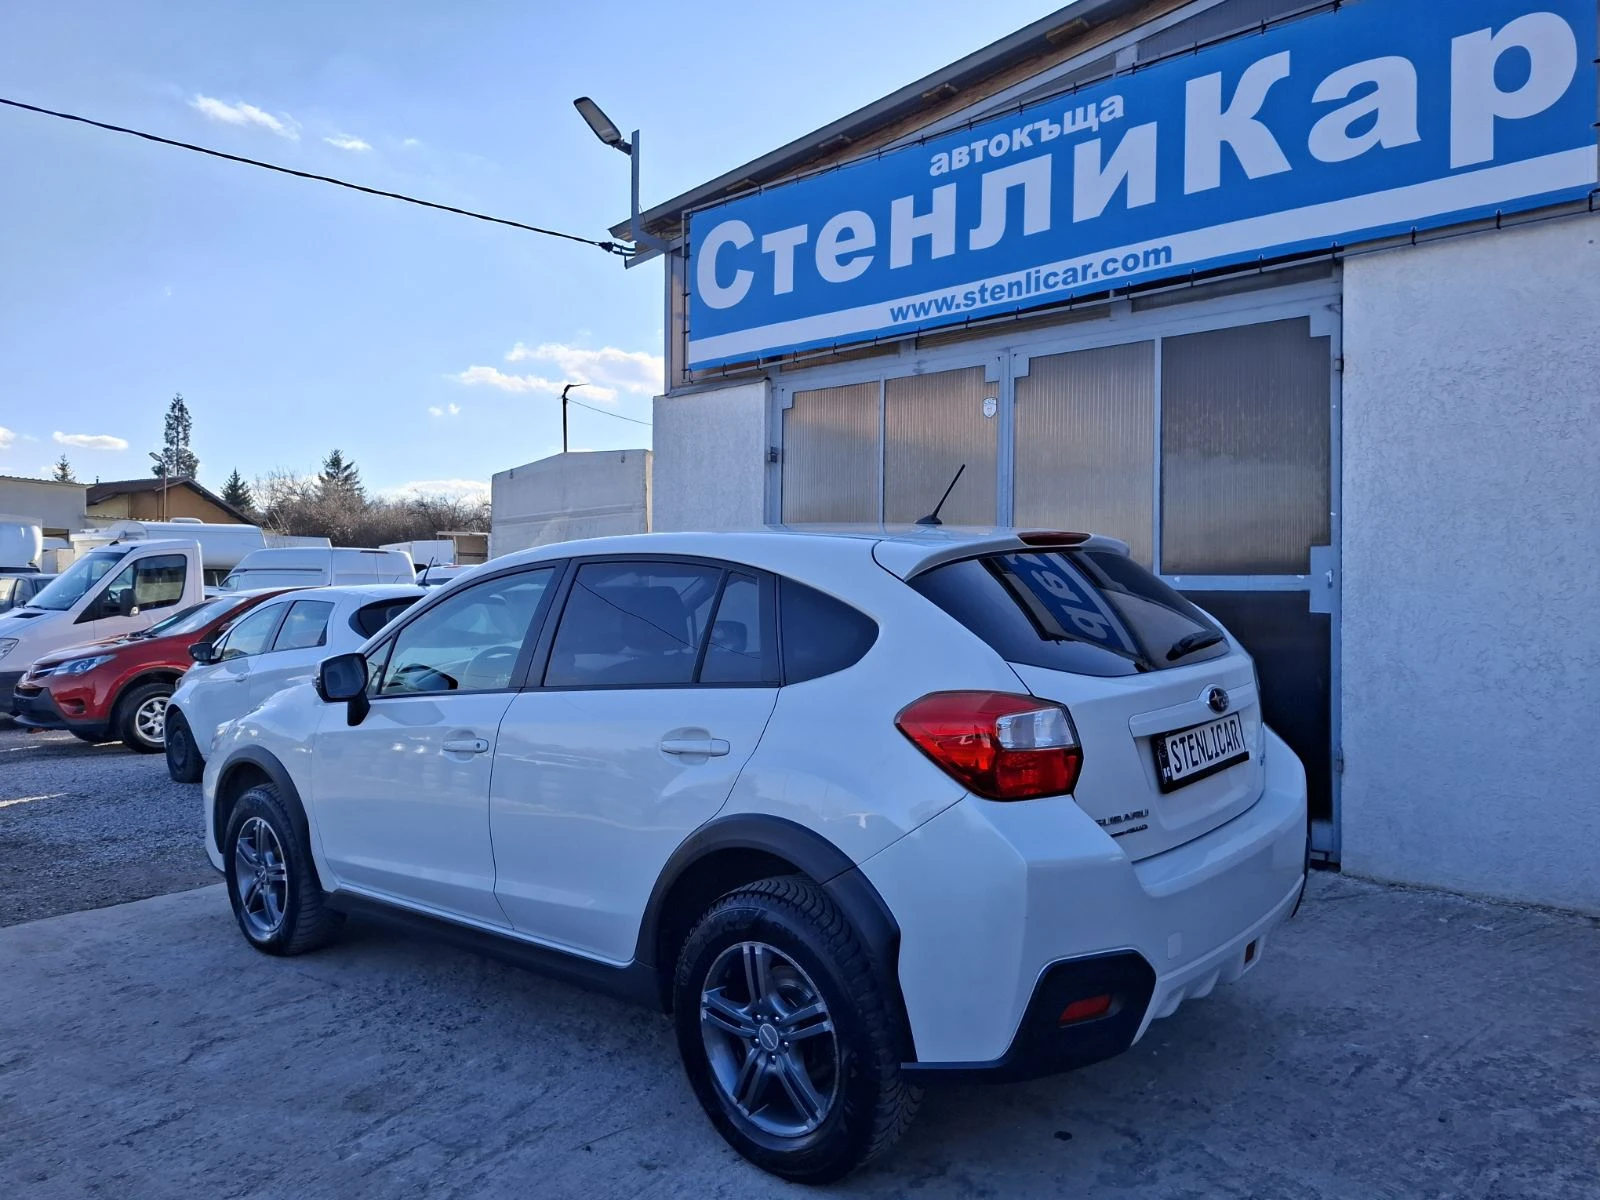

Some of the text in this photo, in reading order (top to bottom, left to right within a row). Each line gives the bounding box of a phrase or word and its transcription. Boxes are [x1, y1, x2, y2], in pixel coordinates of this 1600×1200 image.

[929, 95, 1125, 176] автокъща
[890, 245, 1172, 322] www.stenlicar.com
[1170, 719, 1241, 774] STENLICAR
